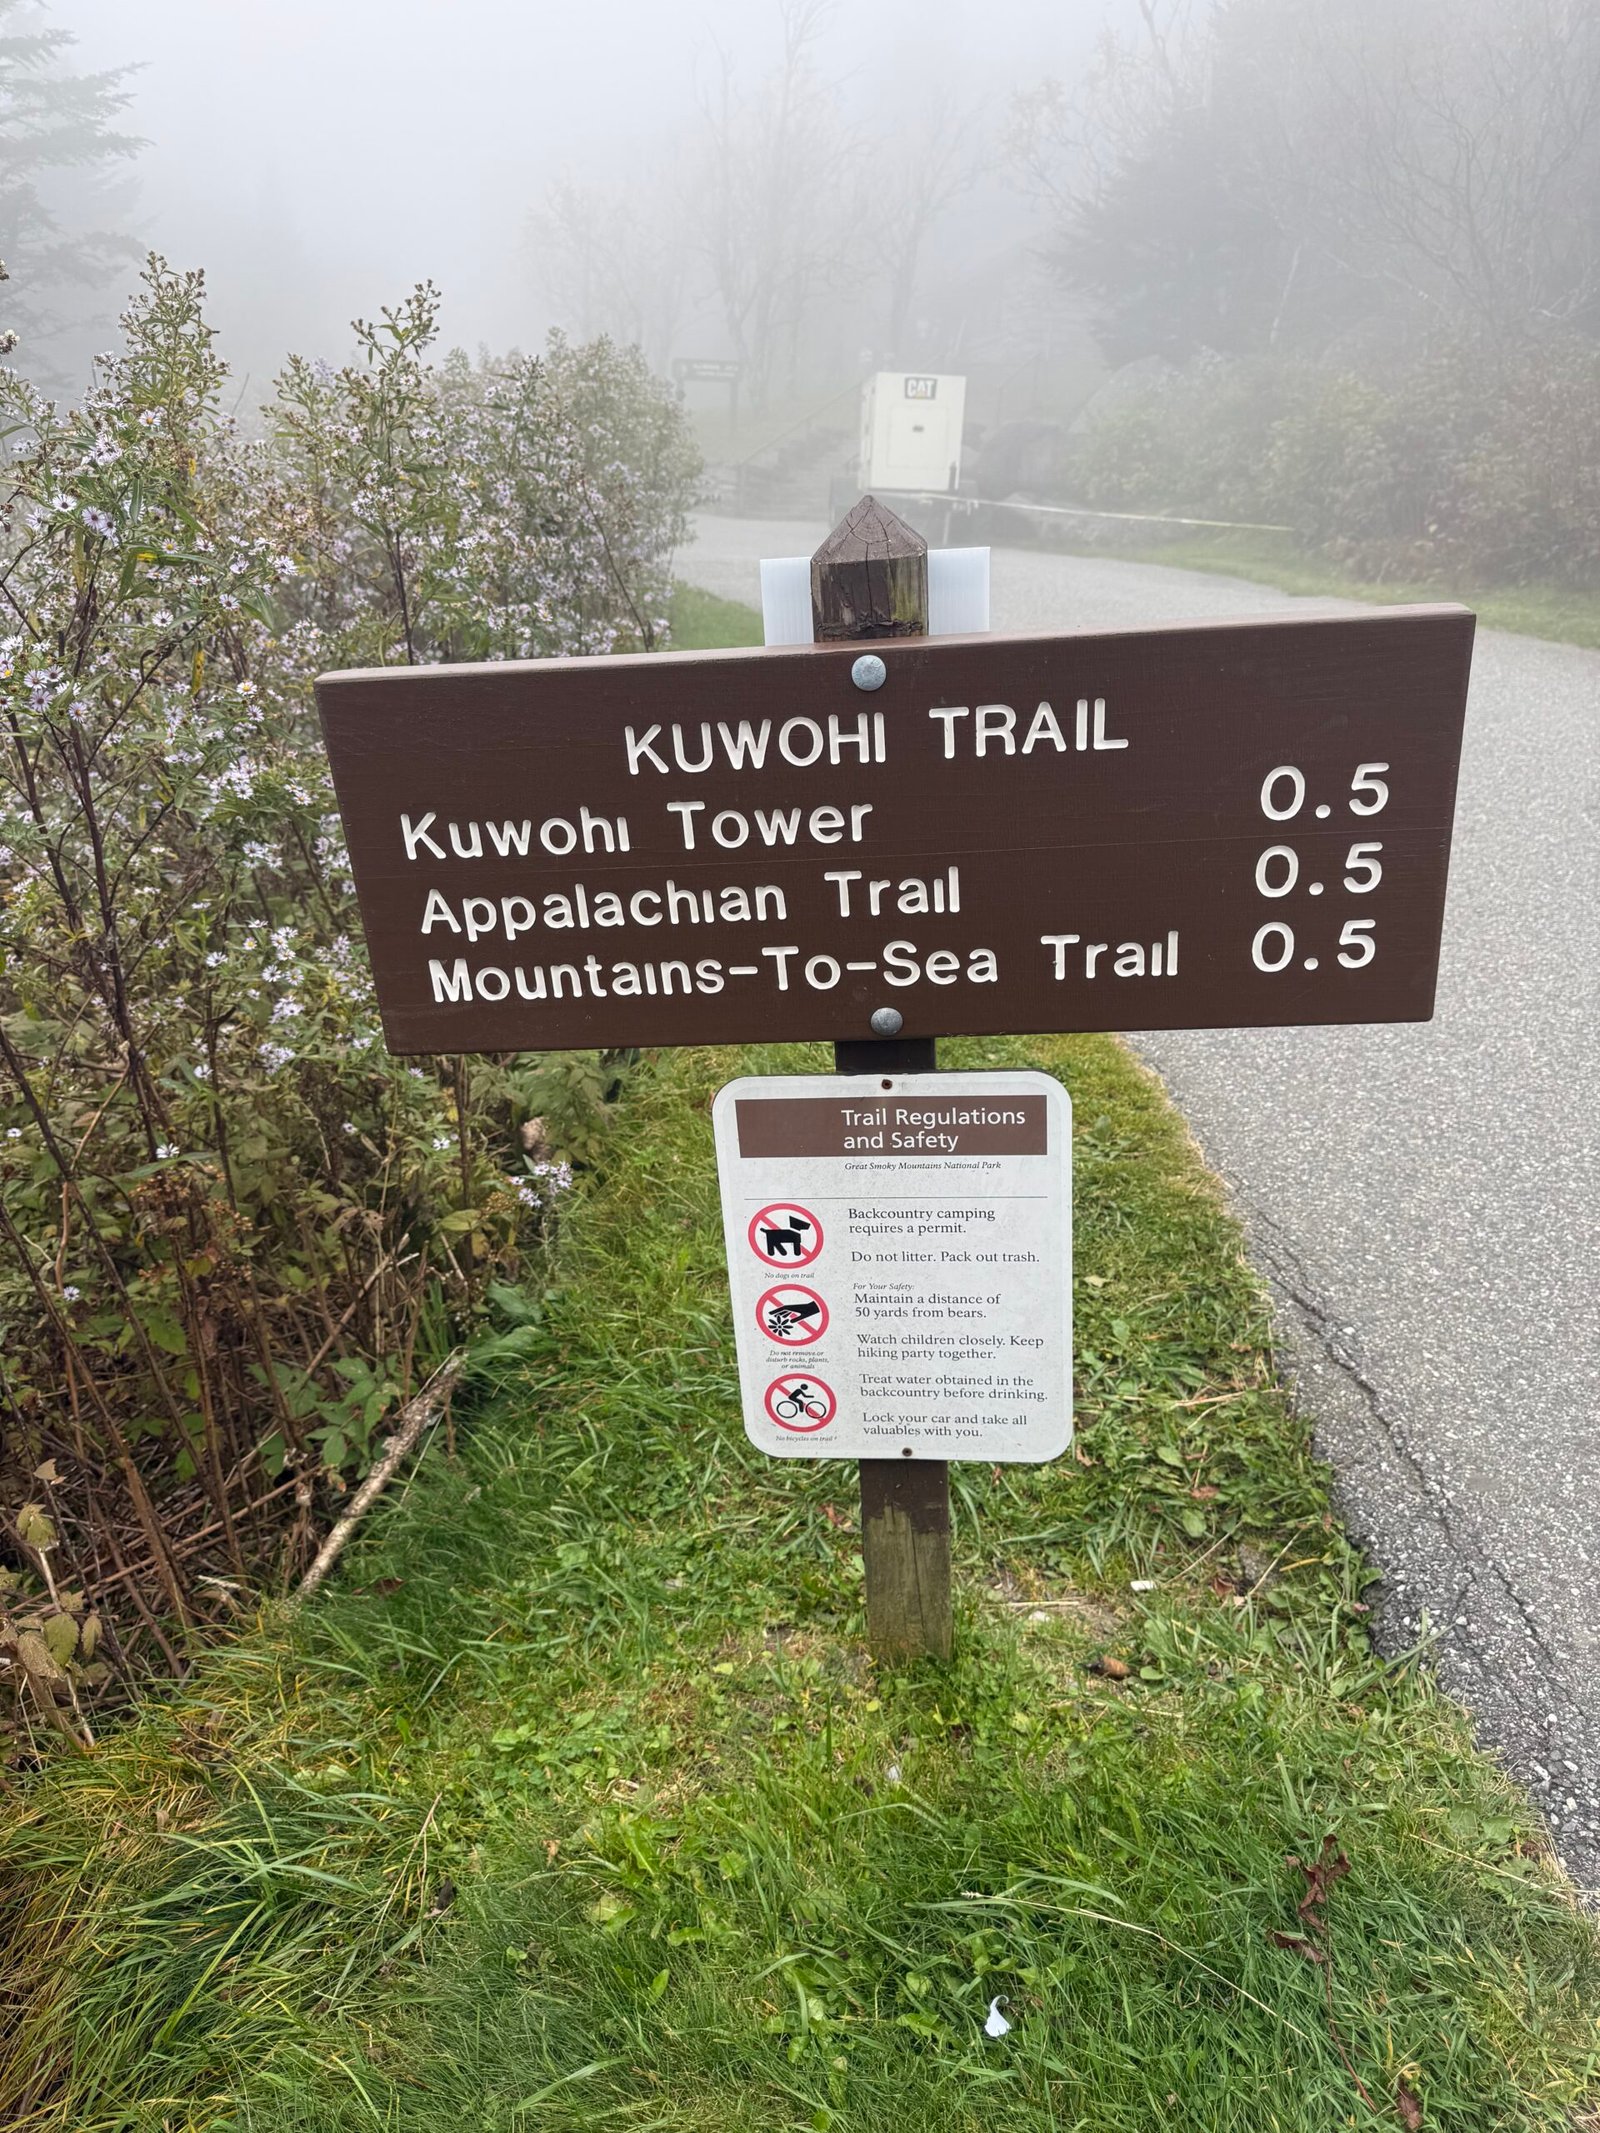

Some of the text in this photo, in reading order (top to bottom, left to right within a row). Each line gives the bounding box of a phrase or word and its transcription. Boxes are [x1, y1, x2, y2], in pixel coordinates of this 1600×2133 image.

[908, 379, 934, 398] CAT
[625, 698, 1129, 775] KUWOHI TRAIL
[401, 762, 1390, 860] Kuwohi Tower 0.5
[421, 842, 1383, 941] Appalachian Trail 0.5
[428, 919, 1376, 1003] Mountains-To-Sea Trail 0.5
[841, 1107, 1026, 1129] Trail Regulations
[843, 1132, 959, 1152] and Safety
[844, 1161, 1002, 1173] Great Smoky Mountains National Park
[848, 1208, 996, 1221] Backcountry camping
[848, 1223, 967, 1235] requires a permit.
[851, 1251, 1040, 1262] Do not litter. Pack out trash.
[775, 1272, 790, 1280] dogs
[888, 1283, 915, 1292] Safety:
[854, 1294, 1002, 1305] Maintain a distance of
[855, 1307, 987, 1321] 50 yards from bears.
[856, 1334, 1044, 1349] Watch children closely. Keep
[857, 1347, 996, 1362] hiking party together.
[859, 1374, 1034, 1387] Treat water obtained in the
[860, 1387, 1048, 1402] backcountry before drinking.
[863, 1413, 1027, 1426] Lock your car and take all
[863, 1425, 983, 1439] valuables with you.
